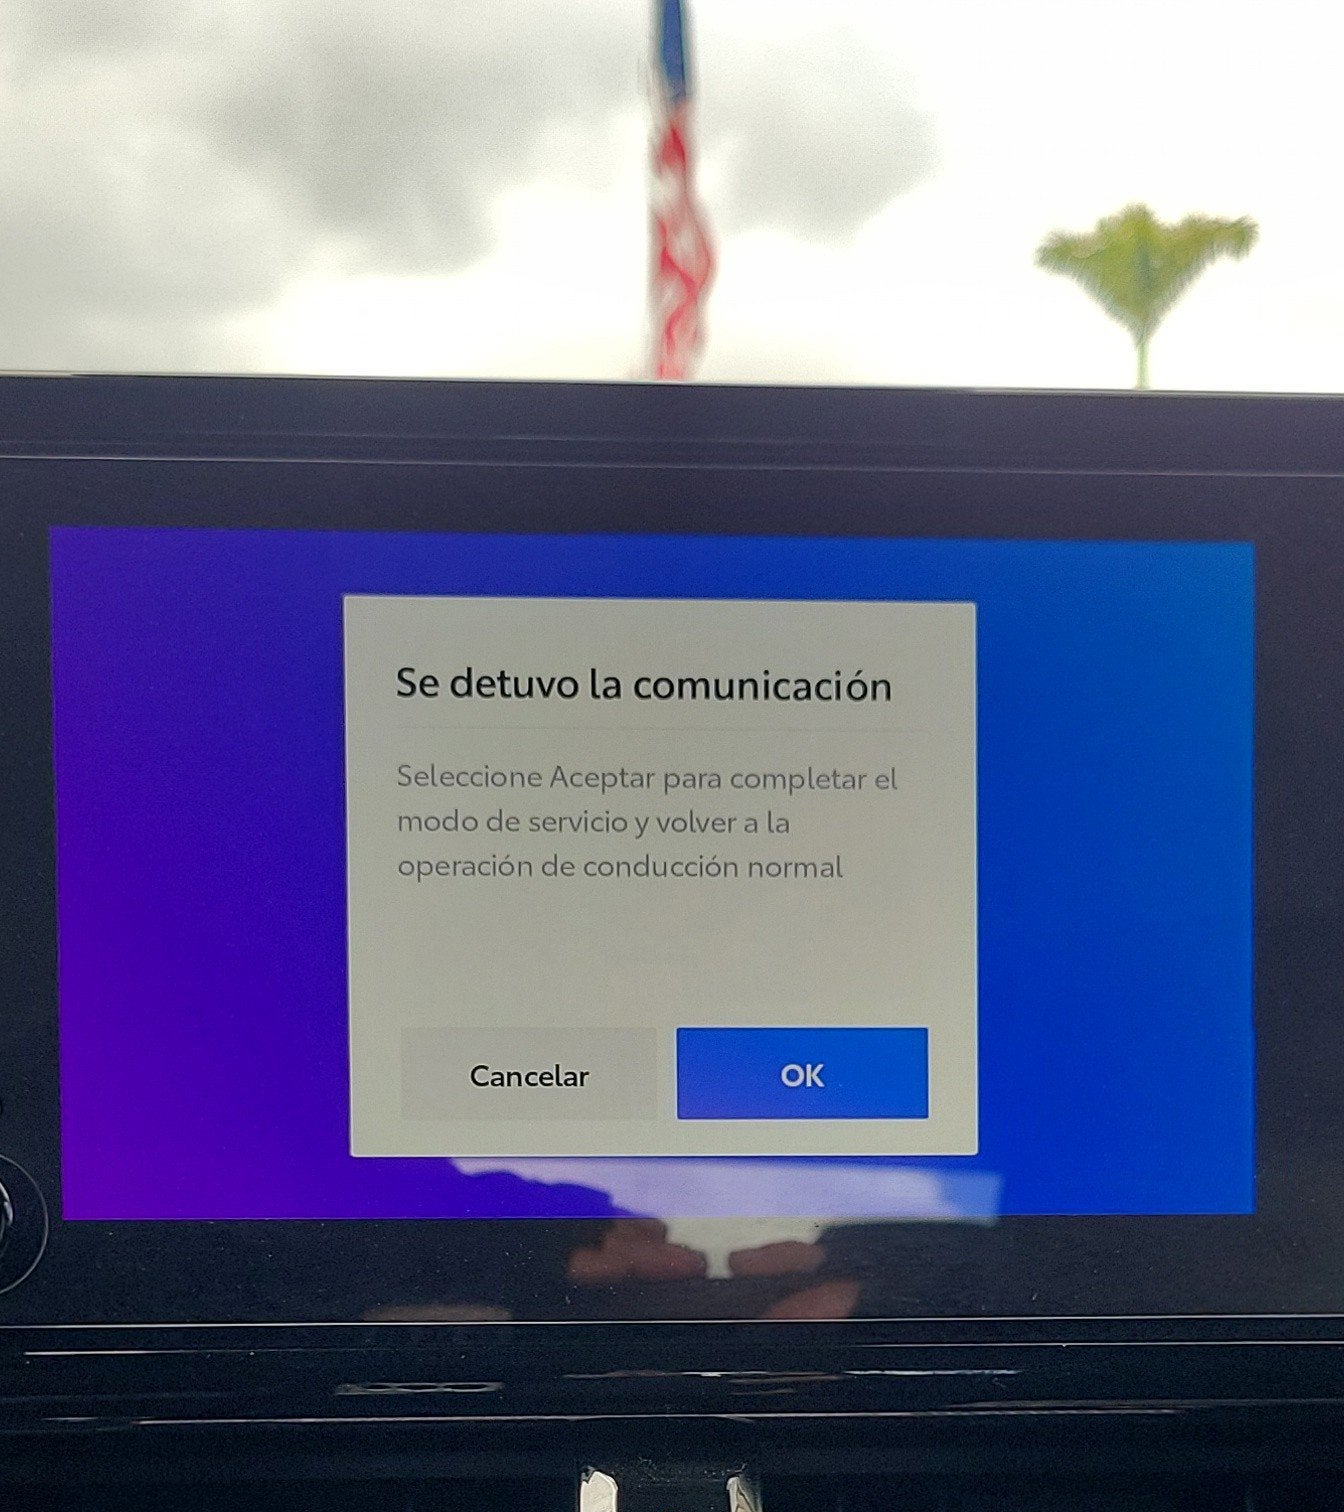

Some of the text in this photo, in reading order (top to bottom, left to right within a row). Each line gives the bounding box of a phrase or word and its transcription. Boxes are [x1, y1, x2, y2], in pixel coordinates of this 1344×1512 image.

[396, 667, 893, 702] Se detuvo la comunicación
[396, 764, 899, 796] Seleccione Aceptar para completar el
[397, 809, 790, 840] modo de servicio y volver a la
[397, 854, 844, 883] operación de conducción normal
[469, 1063, 590, 1088] Cancelar
[780, 1063, 825, 1088] OK
